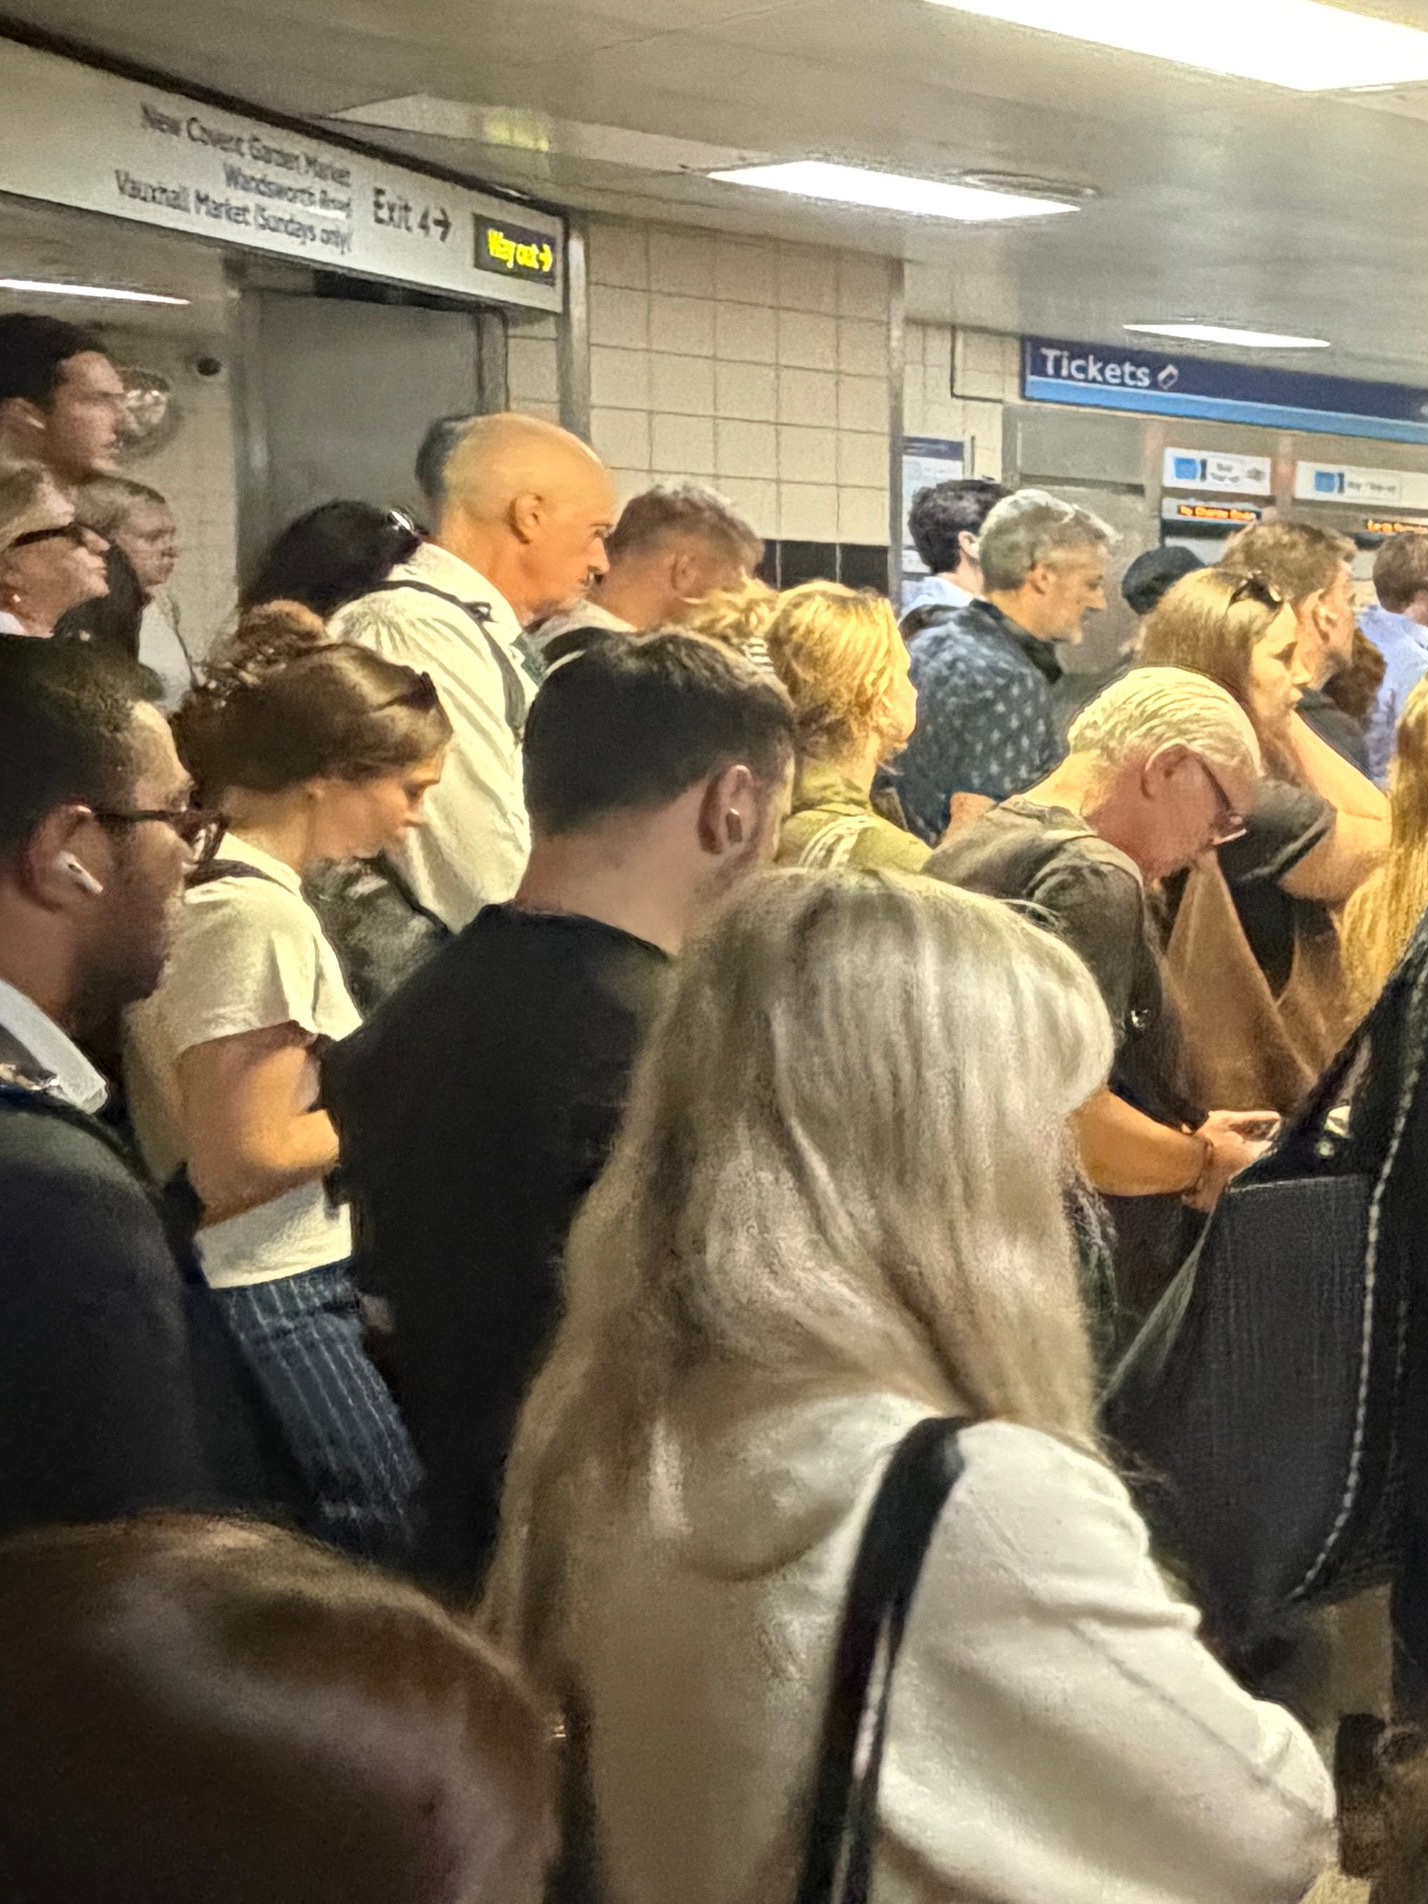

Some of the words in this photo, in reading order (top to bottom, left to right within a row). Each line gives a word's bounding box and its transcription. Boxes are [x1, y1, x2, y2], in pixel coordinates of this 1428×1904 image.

[373, 186, 413, 233] Exit
[418, 207, 431, 237] 4
[487, 228, 517, 269] Way
[516, 242, 540, 270] out
[1039, 347, 1152, 388] Tickets
